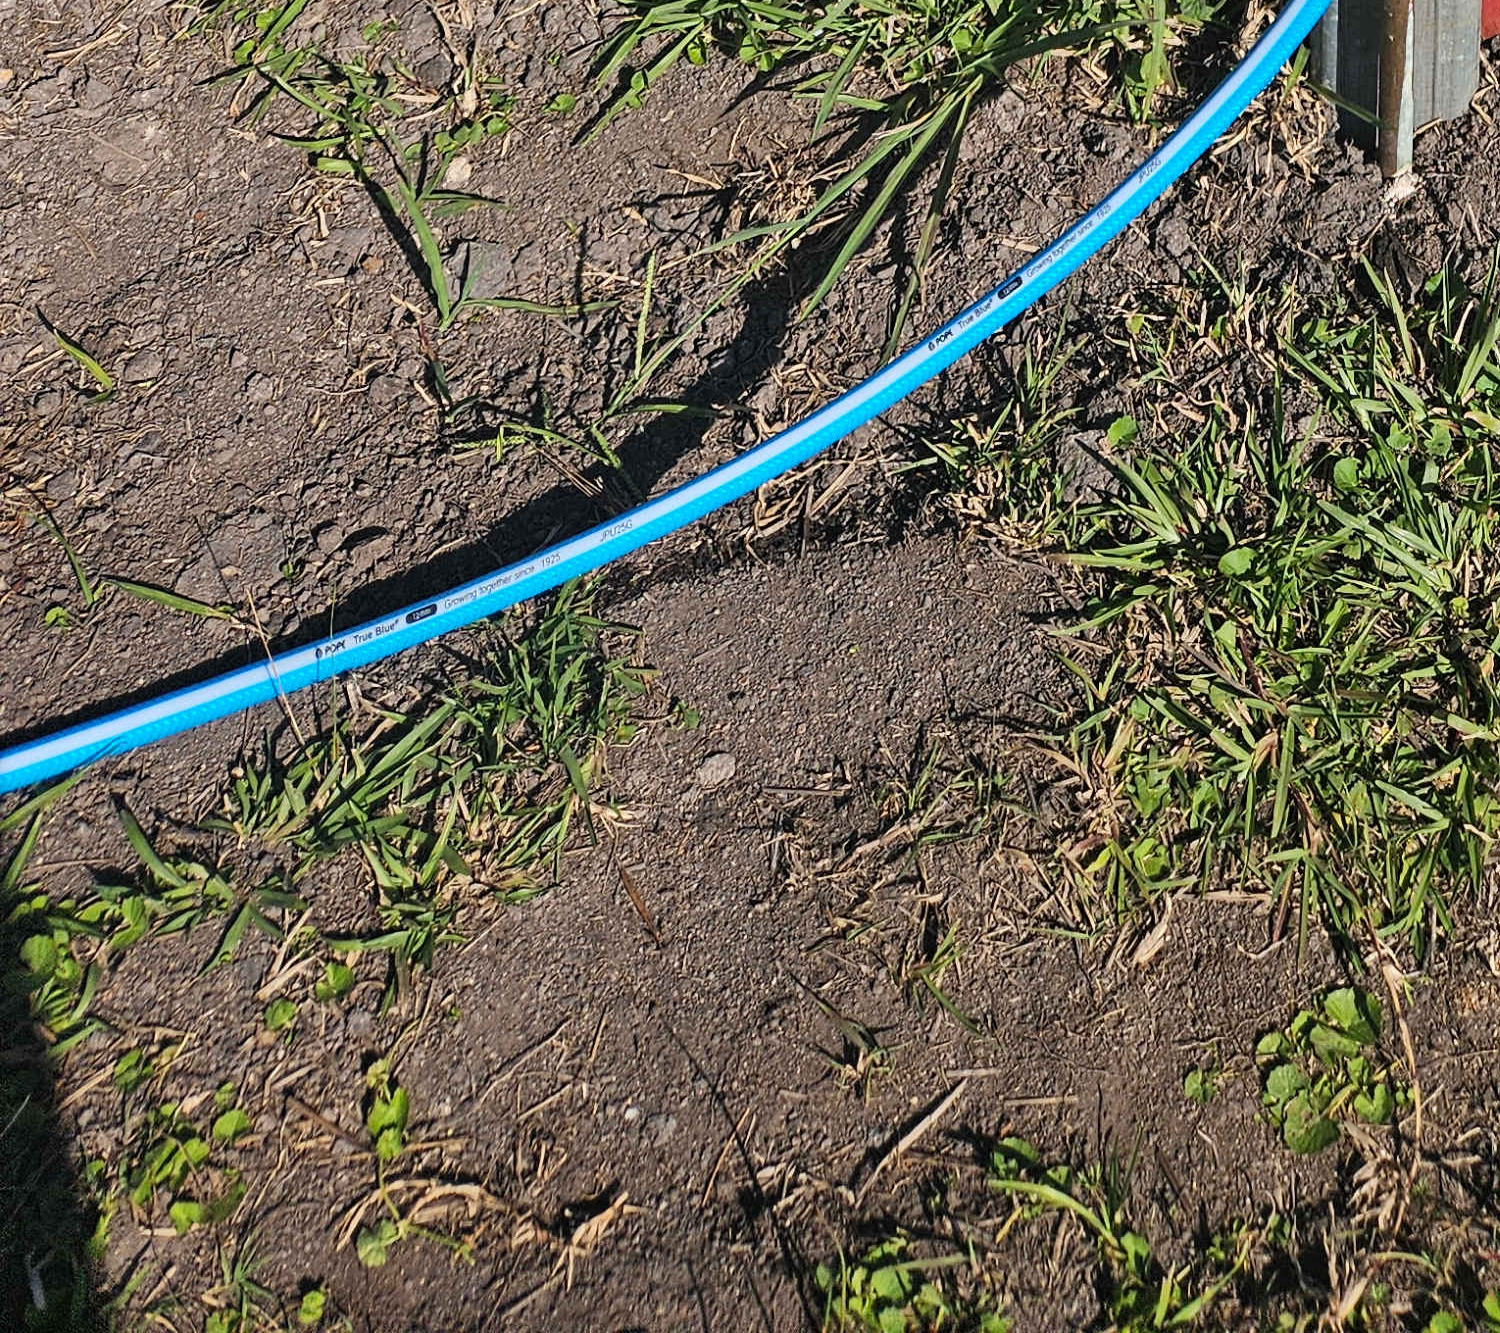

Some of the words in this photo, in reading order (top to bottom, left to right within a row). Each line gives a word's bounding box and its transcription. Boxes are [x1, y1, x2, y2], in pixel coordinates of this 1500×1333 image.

[958, 314, 974, 330] True
[353, 631, 373, 645] True
[444, 589, 478, 609] Growing
[478, 574, 513, 596] together
[513, 565, 536, 581] since
[541, 552, 562, 568] 1925
